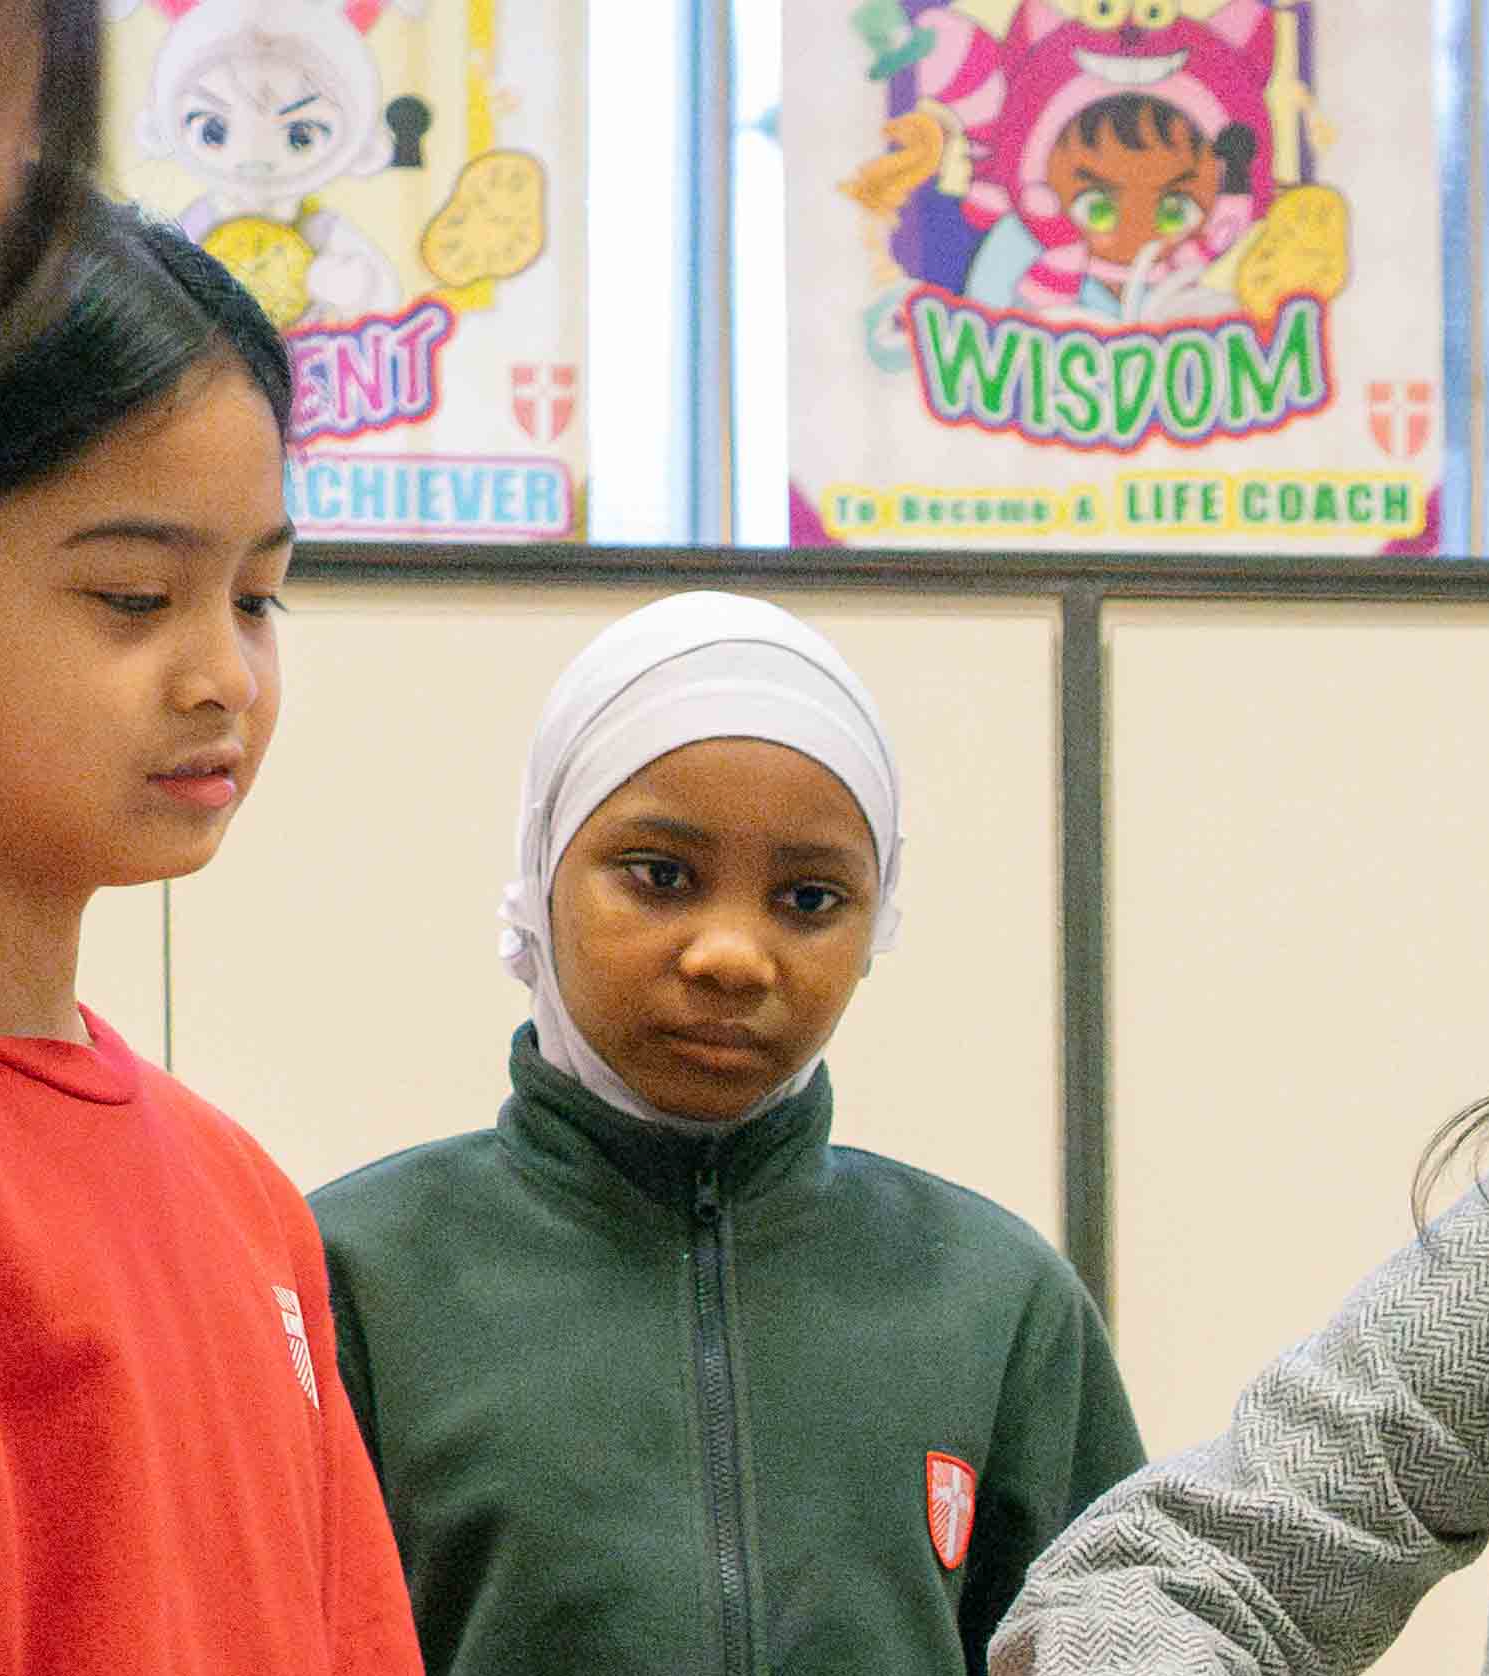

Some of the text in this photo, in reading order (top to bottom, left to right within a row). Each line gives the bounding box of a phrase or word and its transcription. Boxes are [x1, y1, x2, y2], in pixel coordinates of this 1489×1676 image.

[924, 299, 1324, 437] WISDOM
[835, 481, 1410, 524] To Become A LIFE COACH
